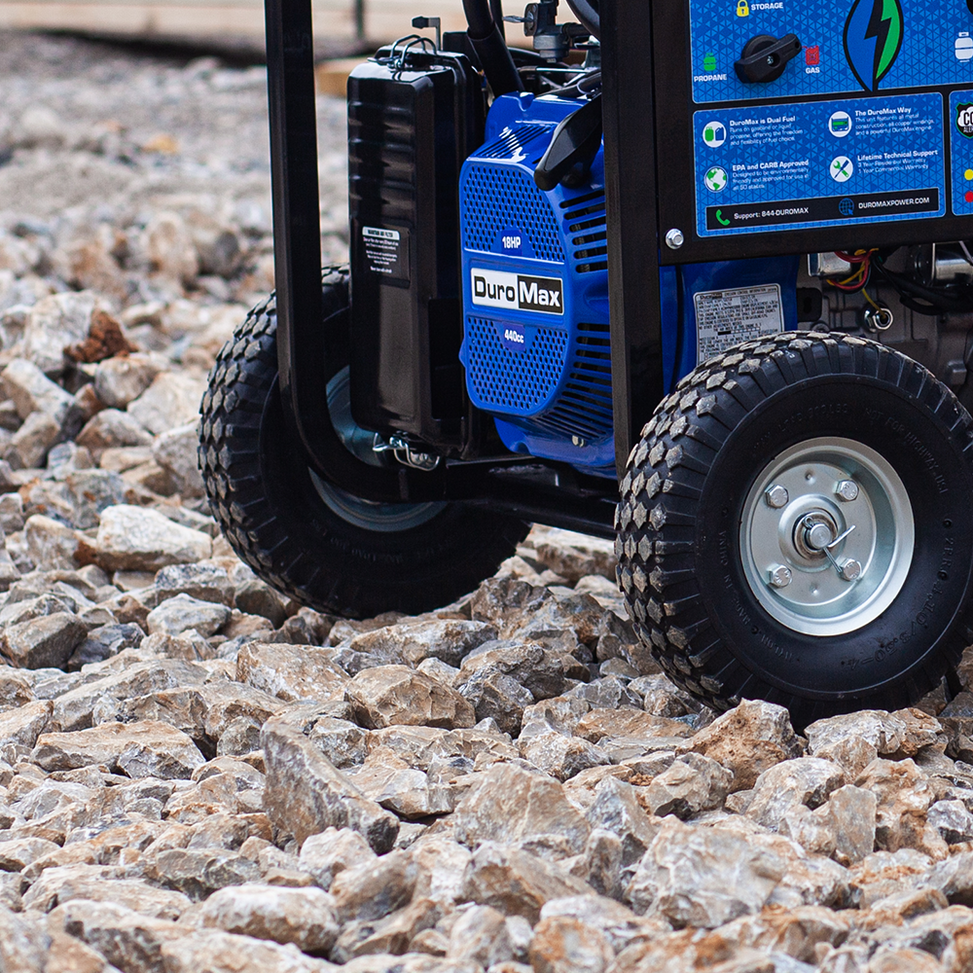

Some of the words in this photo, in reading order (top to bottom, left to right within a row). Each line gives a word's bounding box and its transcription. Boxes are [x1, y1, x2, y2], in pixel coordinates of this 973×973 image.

[750, 1, 784, 11] STORAGE
[804, 66, 821, 74] GAS
[693, 73, 727, 83] PROPANE
[867, 108, 896, 116] DuroMax
[884, 151, 912, 159] Technical
[779, 159, 809, 168] Approved
[858, 196, 930, 210] DUROMAXPOWER.COM
[733, 211, 761, 220] Support:
[502, 236, 521, 249] 18HP
[504, 329, 524, 344] 440cc
